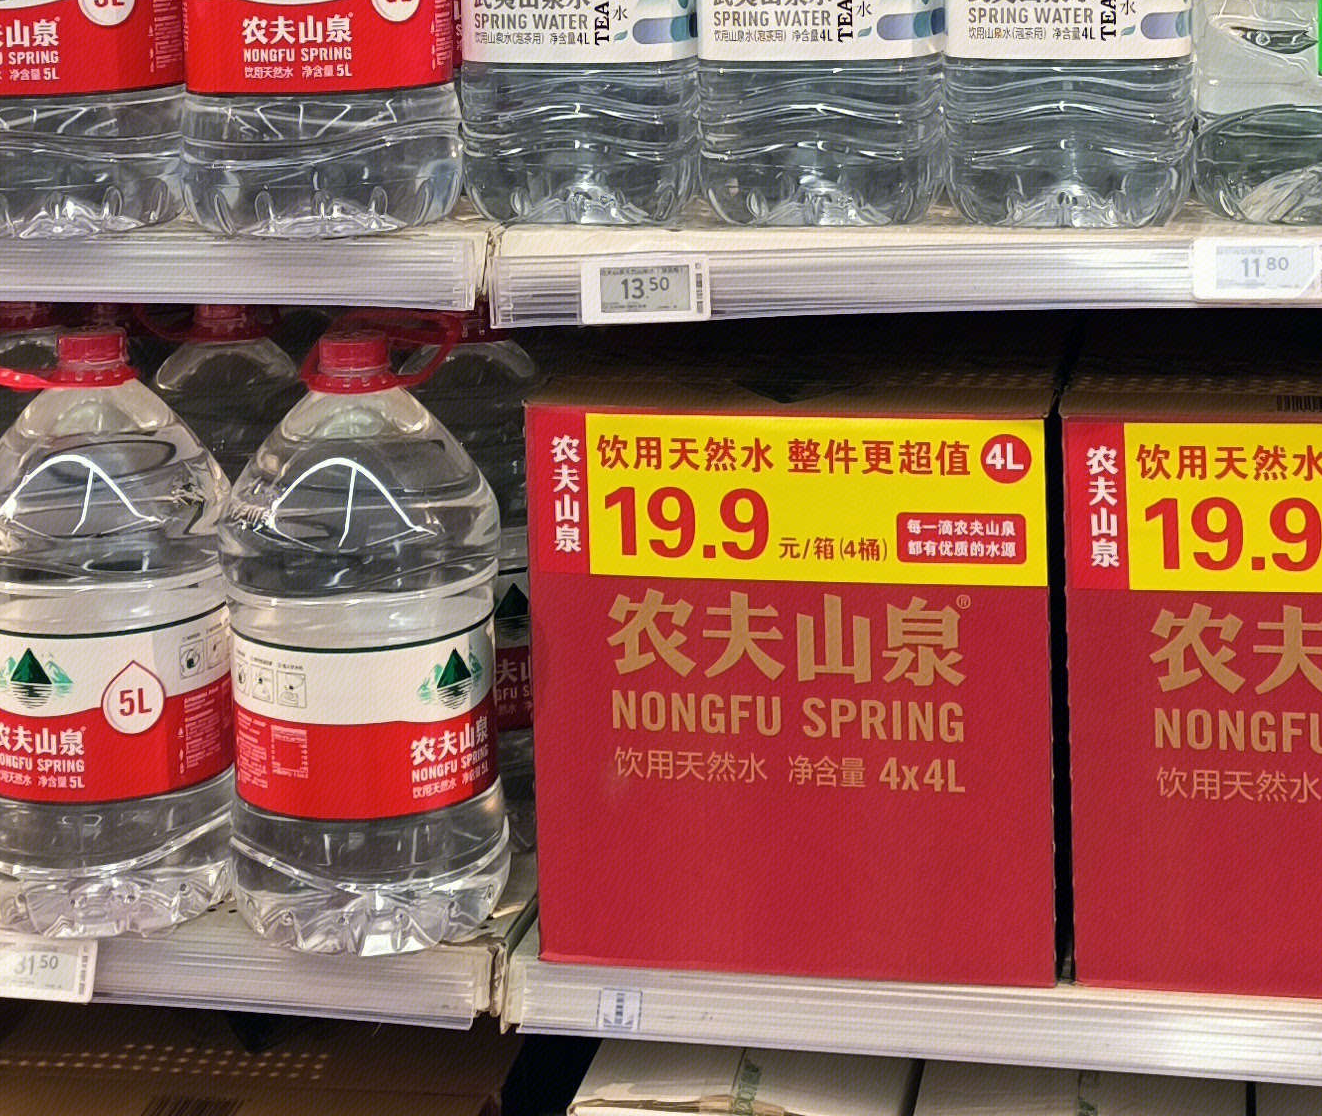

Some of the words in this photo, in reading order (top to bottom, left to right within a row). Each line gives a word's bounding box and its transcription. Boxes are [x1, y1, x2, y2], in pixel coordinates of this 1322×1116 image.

[242, 15, 352, 45] 农夫山泉
[474, 13, 528, 30] SPRING
[532, 13, 589, 30] WATER
[595, 1, 609, 46] TEA
[714, 10, 766, 27] SPRING
[771, 10, 831, 26] WATER
[968, 7, 1029, 24] SPRING
[1035, 7, 1094, 24] WATER
[8, 50, 59, 65] SPRING
[243, 48, 295, 62] NONGFU
[300, 47, 352, 62] SPRING
[596, 434, 774, 472] 饮用天然水
[786, 437, 971, 477] 整件更超值
[984, 443, 1024, 471] 4L
[550, 435, 582, 554] 农夫山泉
[1086, 445, 1120, 568] 农夫山泉
[604, 486, 770, 560] 19.9
[906, 518, 1016, 537] 每一滴农夫山泉
[1143, 496, 1322, 572] 19.9
[907, 540, 1016, 559] 都有优质的水源
[606, 588, 967, 687] 农夫山泉
[119, 688, 153, 717] 5L
[611, 690, 782, 737] NONGFU
[801, 697, 965, 743] SPRING
[410, 715, 488, 766] 农夫山泉
[37, 758, 85, 773] SPRING
[411, 761, 458, 783] NONGFU
[461, 746, 489, 769] SPRING
[613, 746, 768, 784] 饮用天然水
[1155, 767, 1322, 804] 饮用天然水
